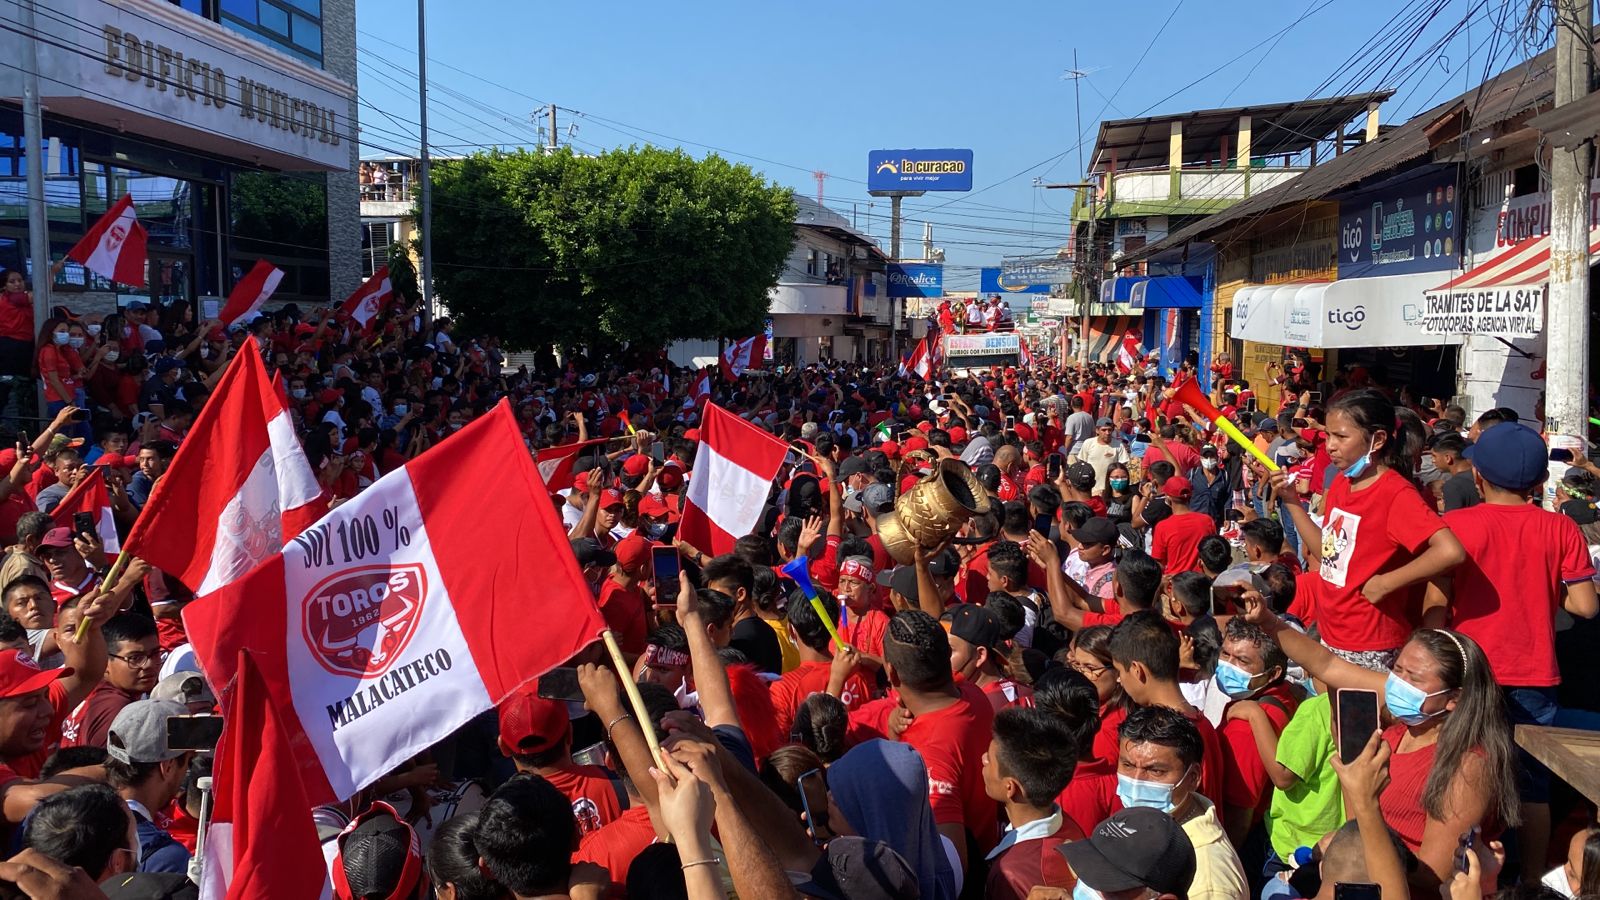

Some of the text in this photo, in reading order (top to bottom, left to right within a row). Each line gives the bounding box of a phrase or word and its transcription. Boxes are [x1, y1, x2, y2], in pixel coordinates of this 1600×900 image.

[104, 24, 340, 146] EDIFICIO MUNICIPAL
[902, 160, 963, 173] la curacao
[1342, 217, 1363, 249] tigo
[1328, 305, 1366, 323] tigo
[1426, 293, 1475, 314] TRAMITES
[1477, 291, 1493, 312] DE
[1495, 290, 1511, 312] LA
[1513, 290, 1541, 312] SAT
[1421, 315, 1475, 333] FOTOCOPIAS,
[1477, 317, 1508, 333] AGENCIA
[294, 523, 334, 568] SOY
[337, 515, 380, 562] 100
[383, 506, 411, 550] %
[317, 572, 409, 620] TOROS
[352, 609, 380, 627] 1962
[326, 648, 452, 732] MALACATECO
